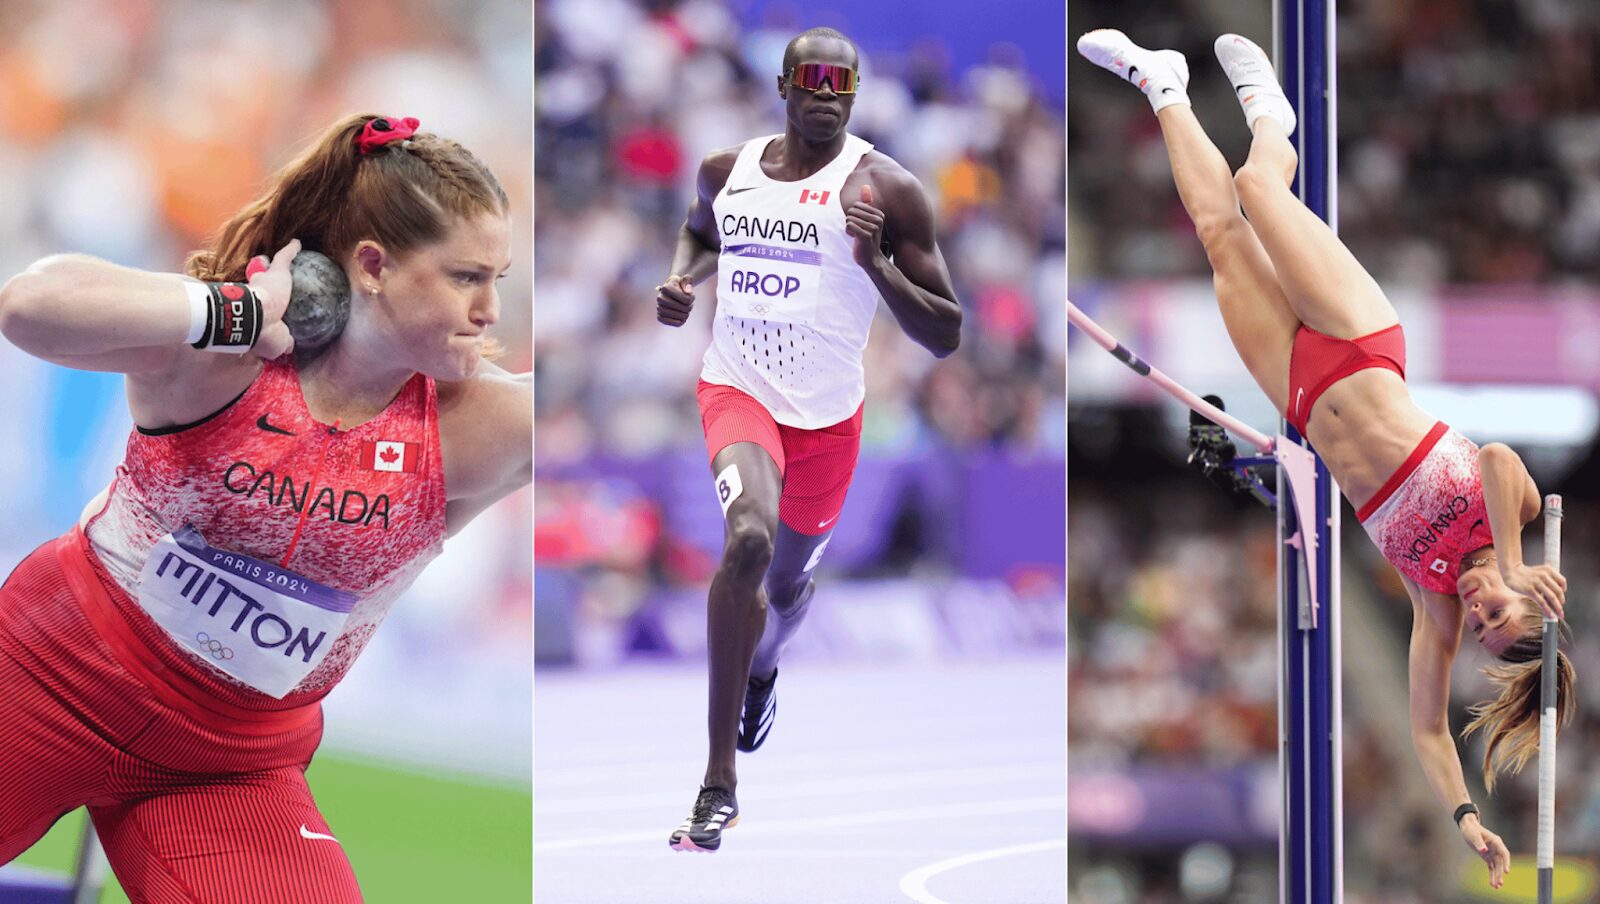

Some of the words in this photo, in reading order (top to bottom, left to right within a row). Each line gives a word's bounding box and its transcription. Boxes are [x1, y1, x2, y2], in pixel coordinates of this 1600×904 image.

[722, 214, 819, 245] CANADA
[769, 248, 794, 259] 2024
[731, 270, 800, 298] AROP
[229, 301, 244, 343] DHE
[223, 462, 391, 529] CANADA
[718, 479, 731, 503] 8
[1402, 496, 1469, 562] CANADA
[213, 553, 261, 577] PARIS
[266, 571, 308, 594] 2024
[155, 551, 327, 663] MITTON
